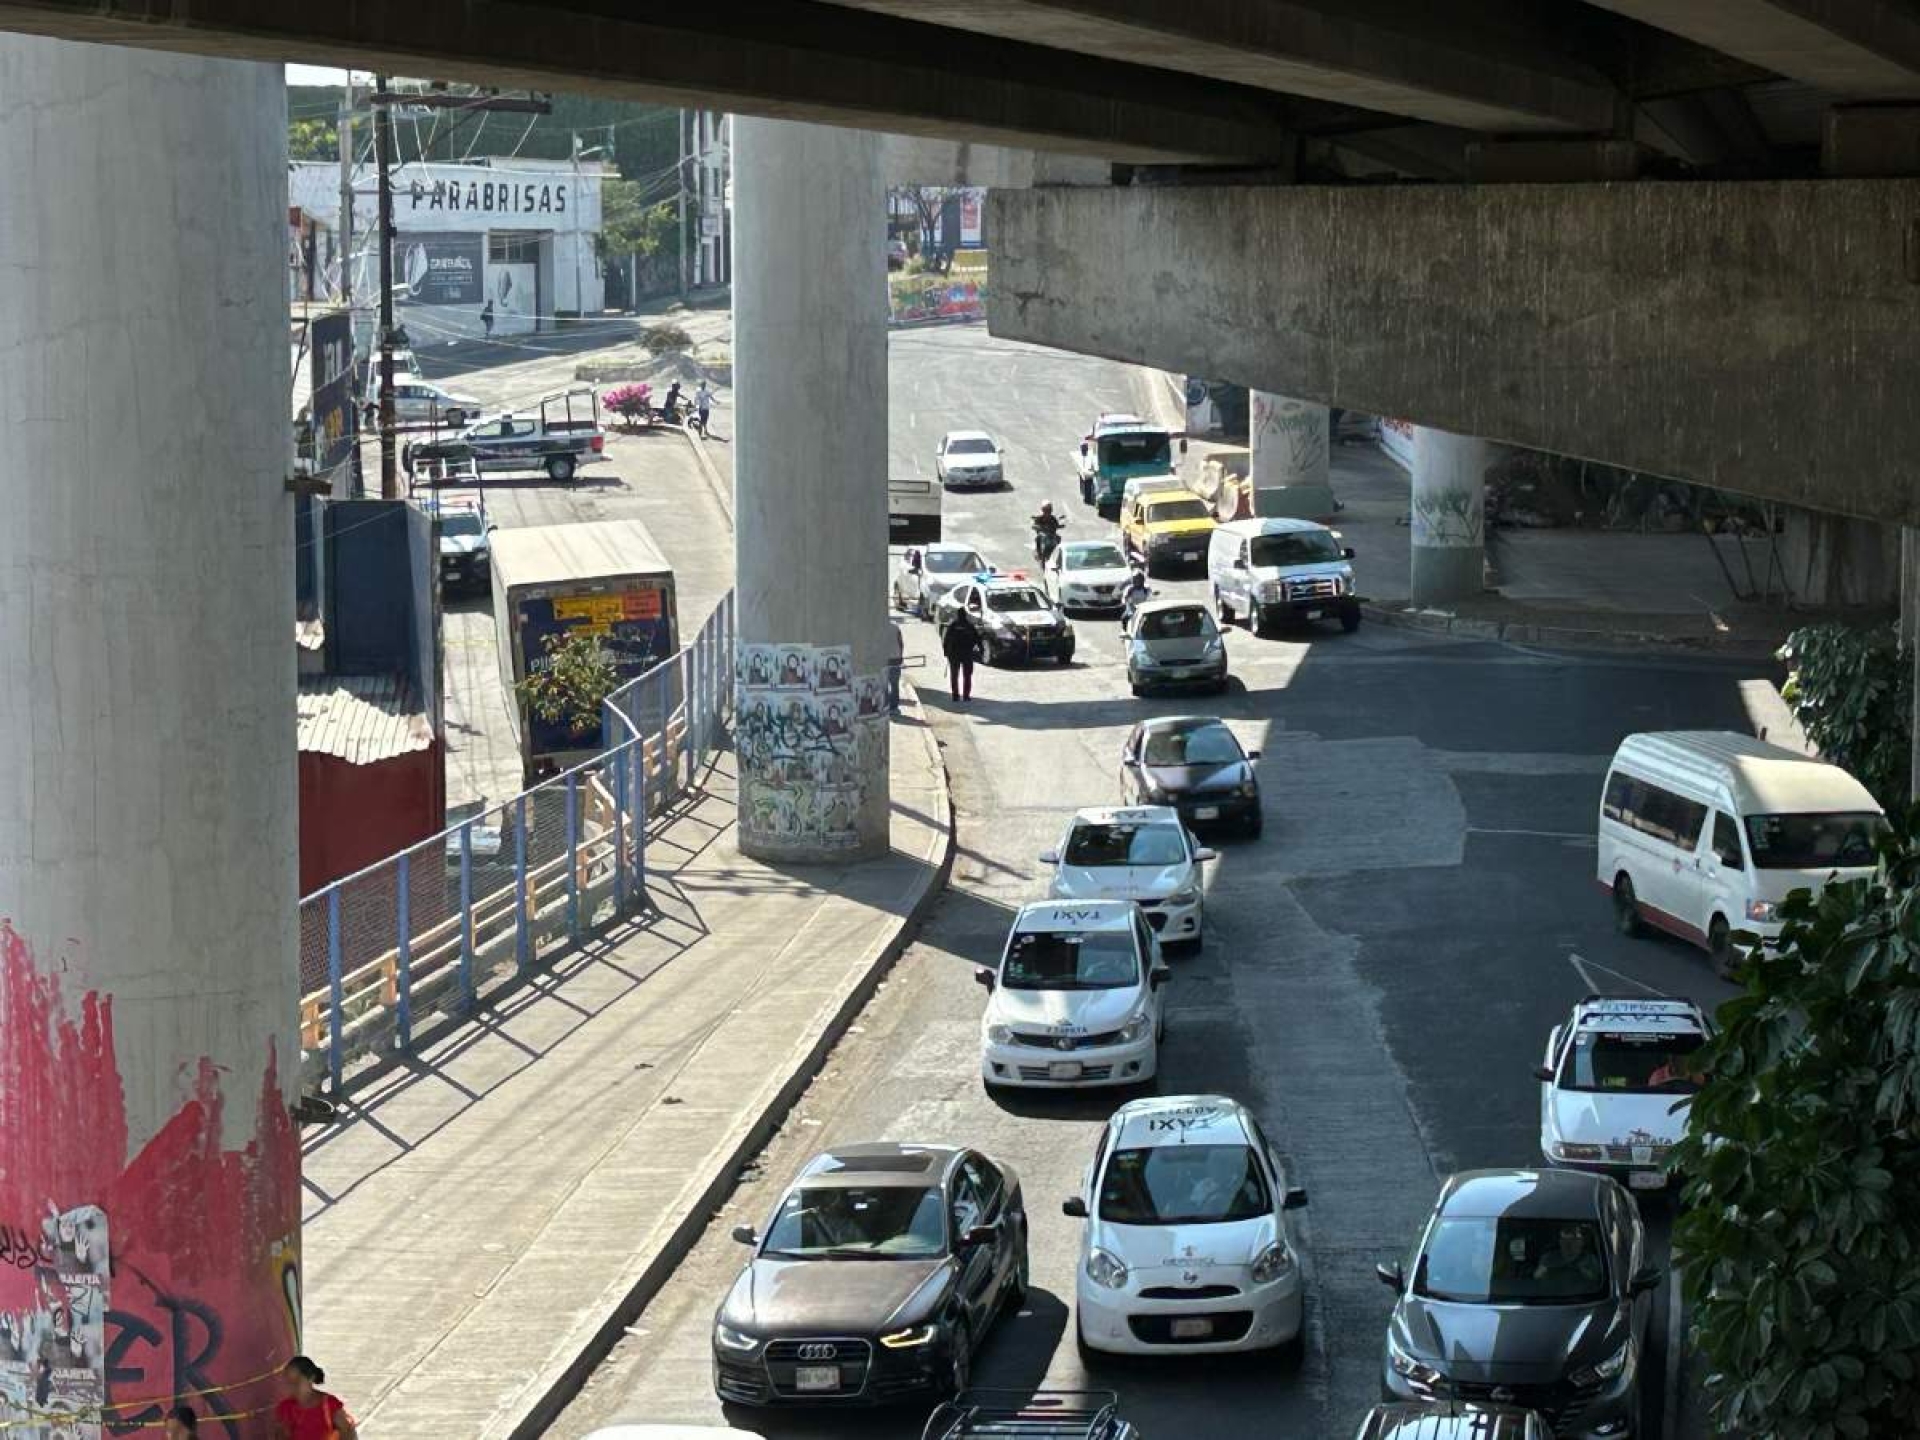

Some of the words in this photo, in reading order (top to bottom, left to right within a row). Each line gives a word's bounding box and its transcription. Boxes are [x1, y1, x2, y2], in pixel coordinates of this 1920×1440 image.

[411, 179, 566, 213] PARABRISAS
[1101, 810, 1152, 820] TAXI
[1053, 910, 1101, 921] TAXI
[1149, 1118, 1211, 1132] TAXI
